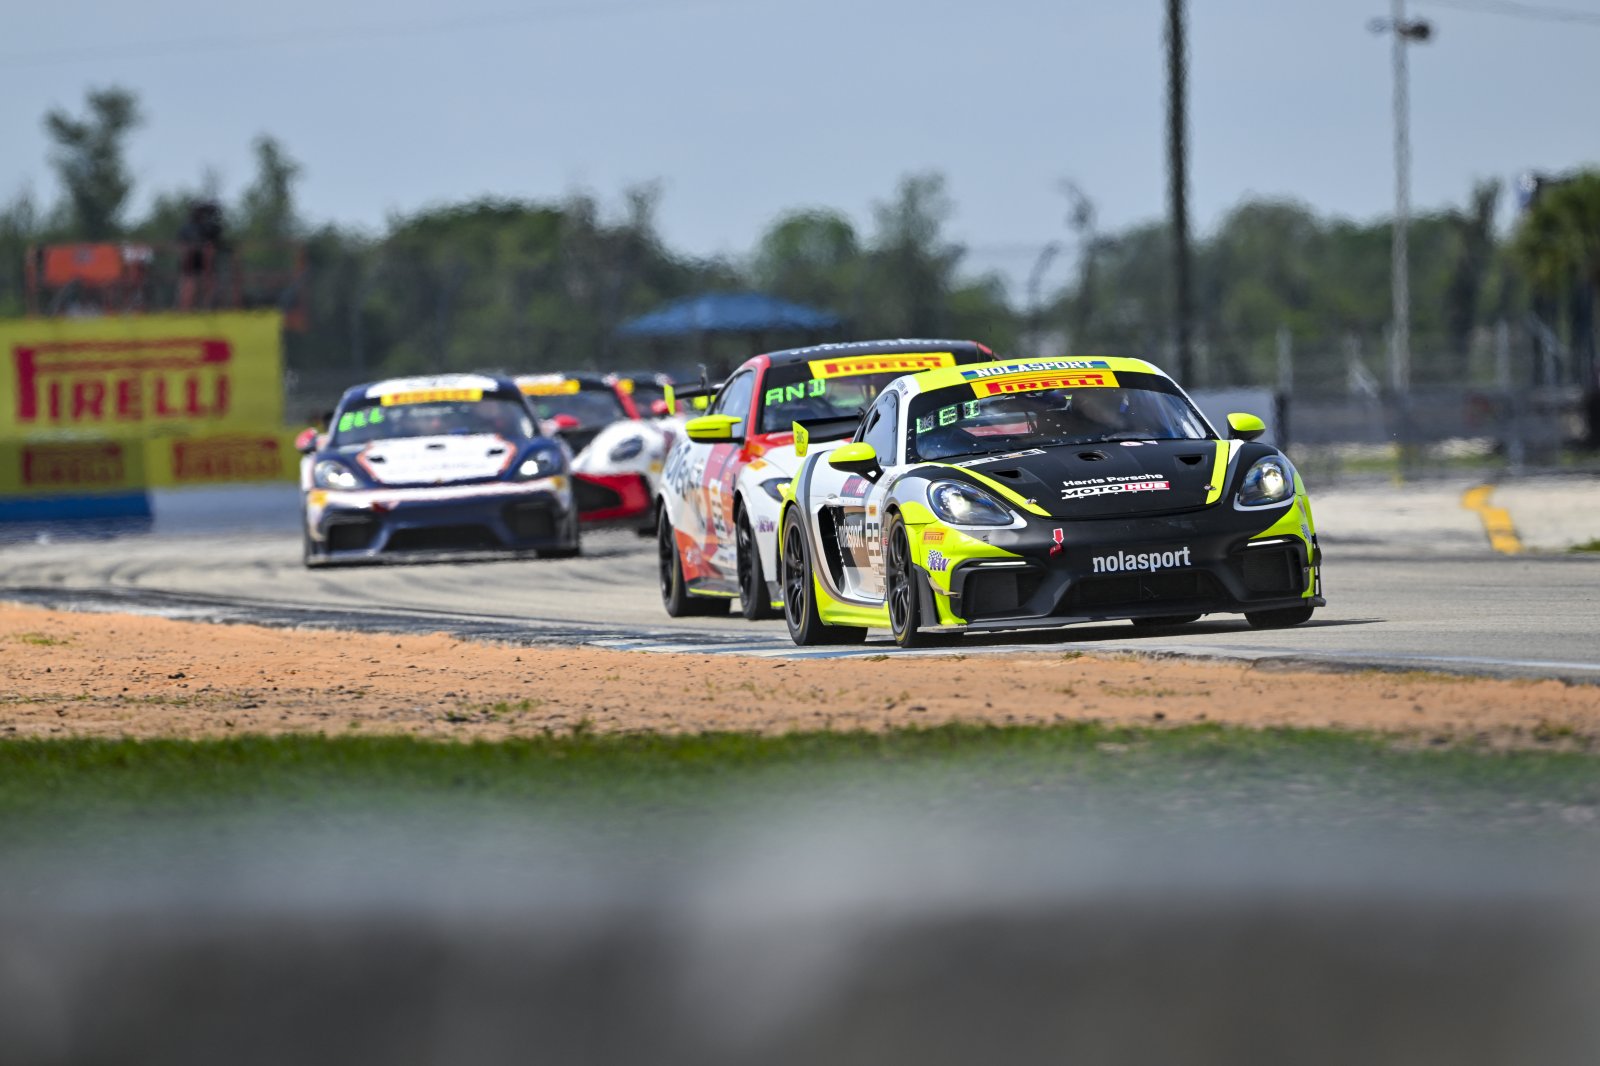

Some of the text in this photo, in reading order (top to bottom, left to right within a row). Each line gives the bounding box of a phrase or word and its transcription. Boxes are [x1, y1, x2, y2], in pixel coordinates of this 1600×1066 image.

[824, 356, 941, 374] PIRELLI
[976, 360, 1094, 378] NOLASPORT
[14, 340, 231, 422] PIRELLI
[986, 374, 1105, 394] PIRELLI
[765, 378, 826, 406] AND
[1063, 473, 1164, 487] Harris Porsche
[1092, 546, 1192, 573] nolasport
